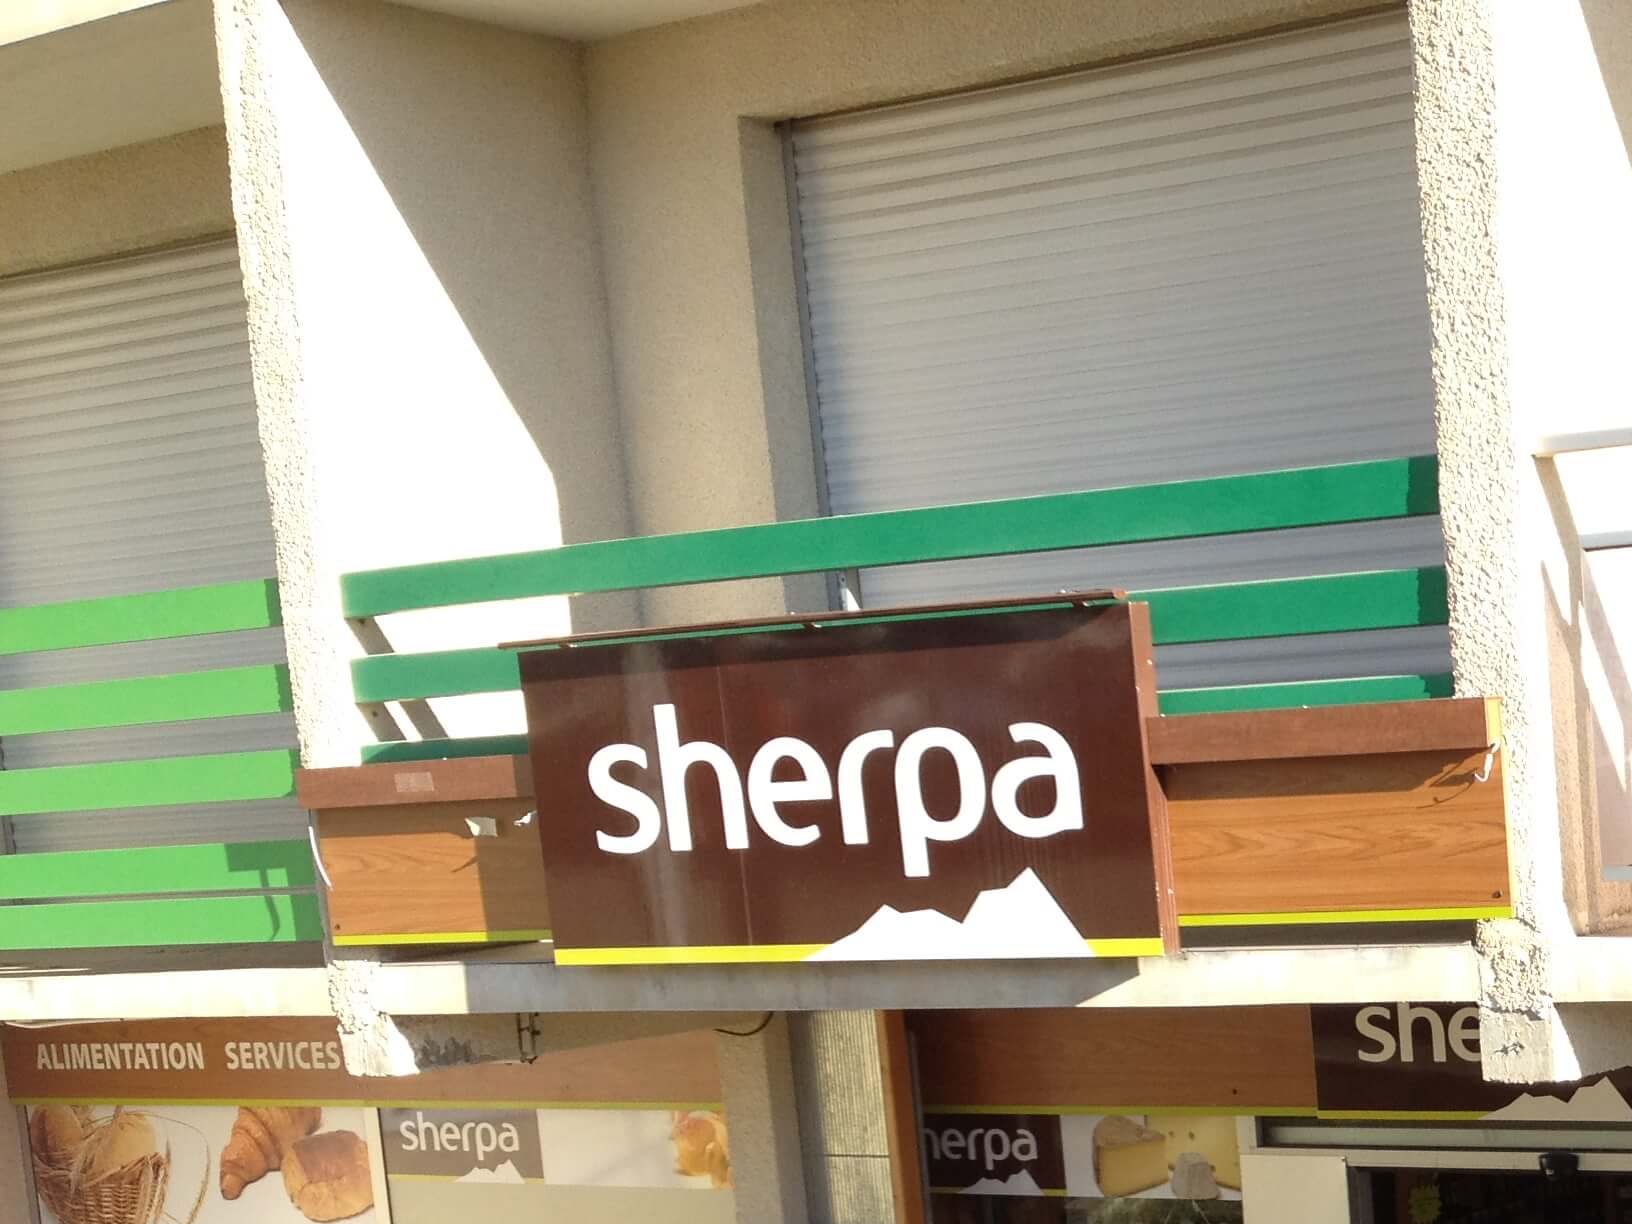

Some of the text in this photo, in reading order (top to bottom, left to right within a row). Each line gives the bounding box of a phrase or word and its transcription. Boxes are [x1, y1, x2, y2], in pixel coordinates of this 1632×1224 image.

[587, 703, 1084, 878] sherpa
[37, 1040, 341, 1071] ALIMENTATION SERVICES
[399, 1111, 520, 1161] sherpa
